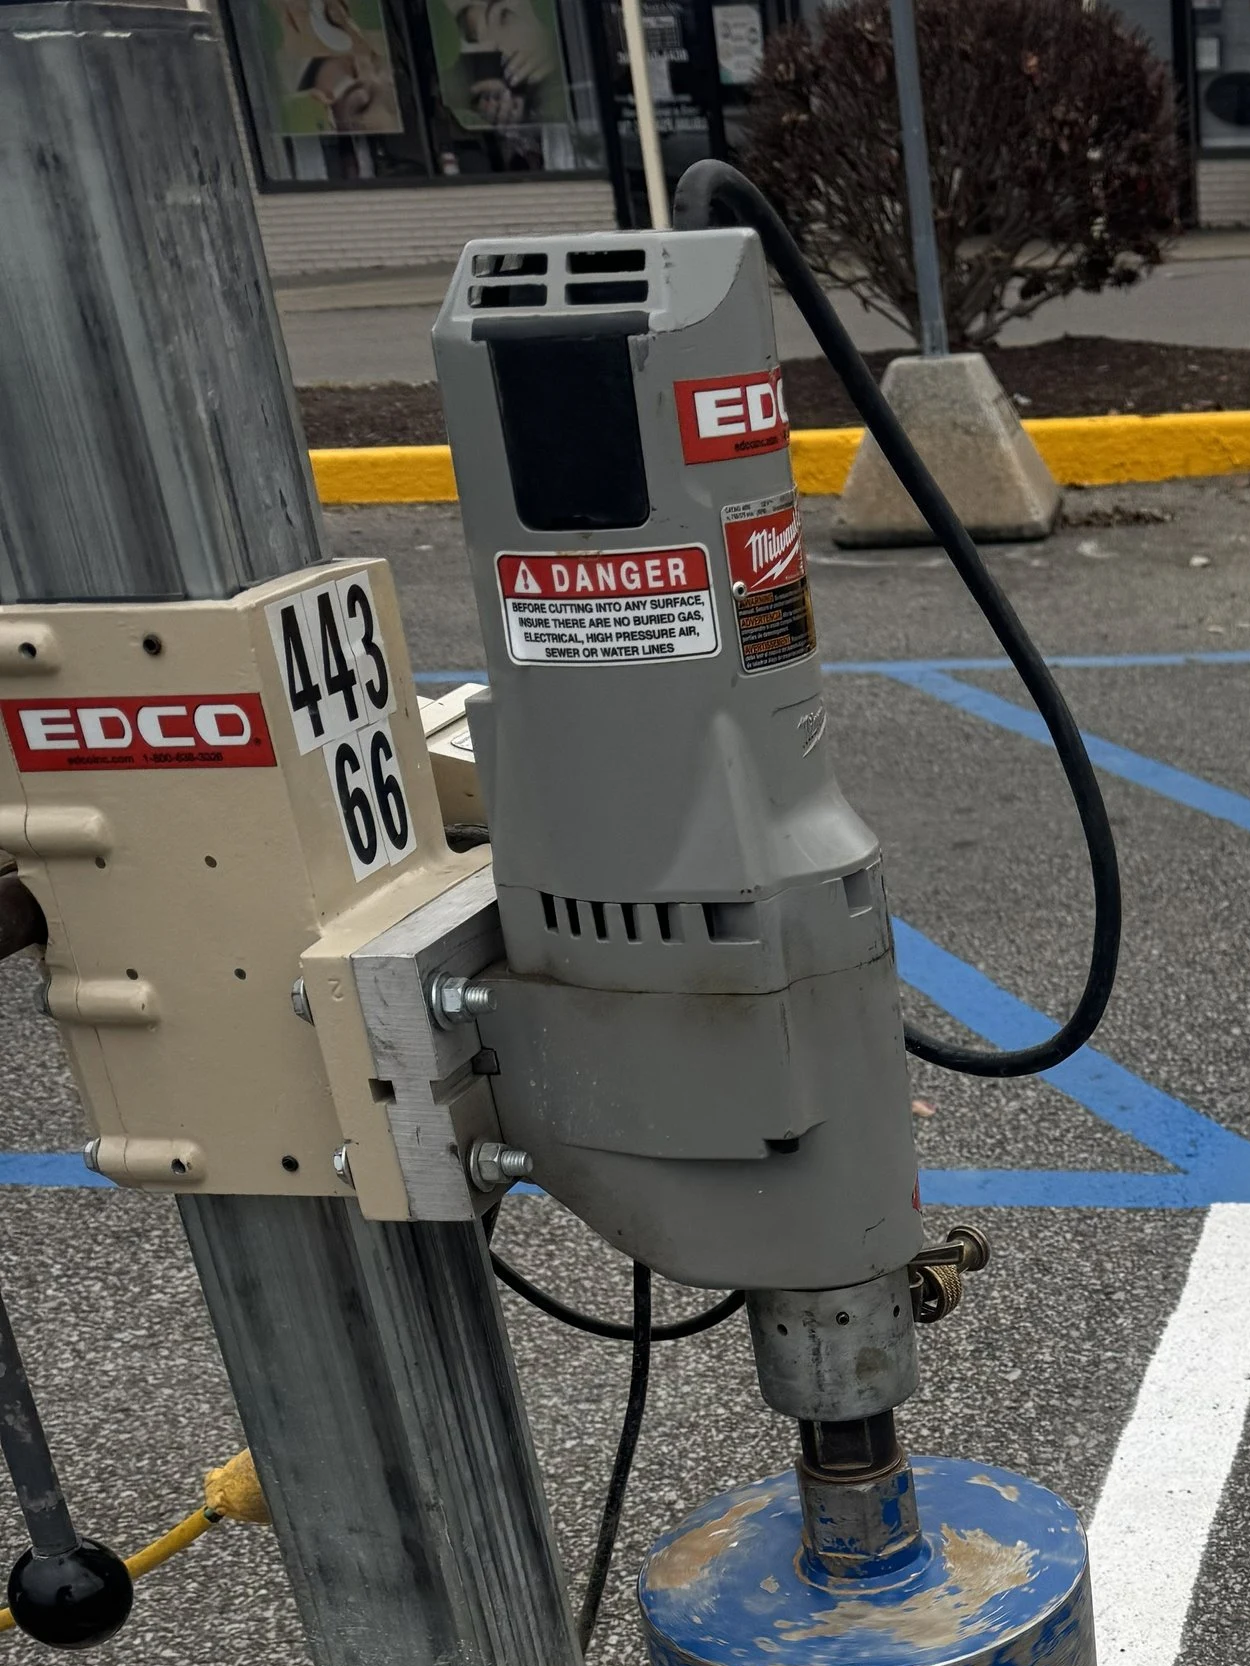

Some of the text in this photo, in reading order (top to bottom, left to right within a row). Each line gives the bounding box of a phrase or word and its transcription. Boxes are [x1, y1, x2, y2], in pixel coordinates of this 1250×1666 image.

[694, 378, 789, 438] ED
[552, 557, 687, 592] DANGER
[512, 594, 705, 613] BEFORE CUTTING INTO ANY SURFACE,
[519, 610, 704, 628] INSURE THERE ARE NO BURIED GAS,
[524, 626, 700, 645] ELECTRICAL, HIGH PRESSURE AIR,
[545, 643, 675, 658] SEWER OR WATER LINES
[279, 584, 389, 738] 443
[18, 704, 252, 750] EDCO
[335, 730, 408, 866] 66
